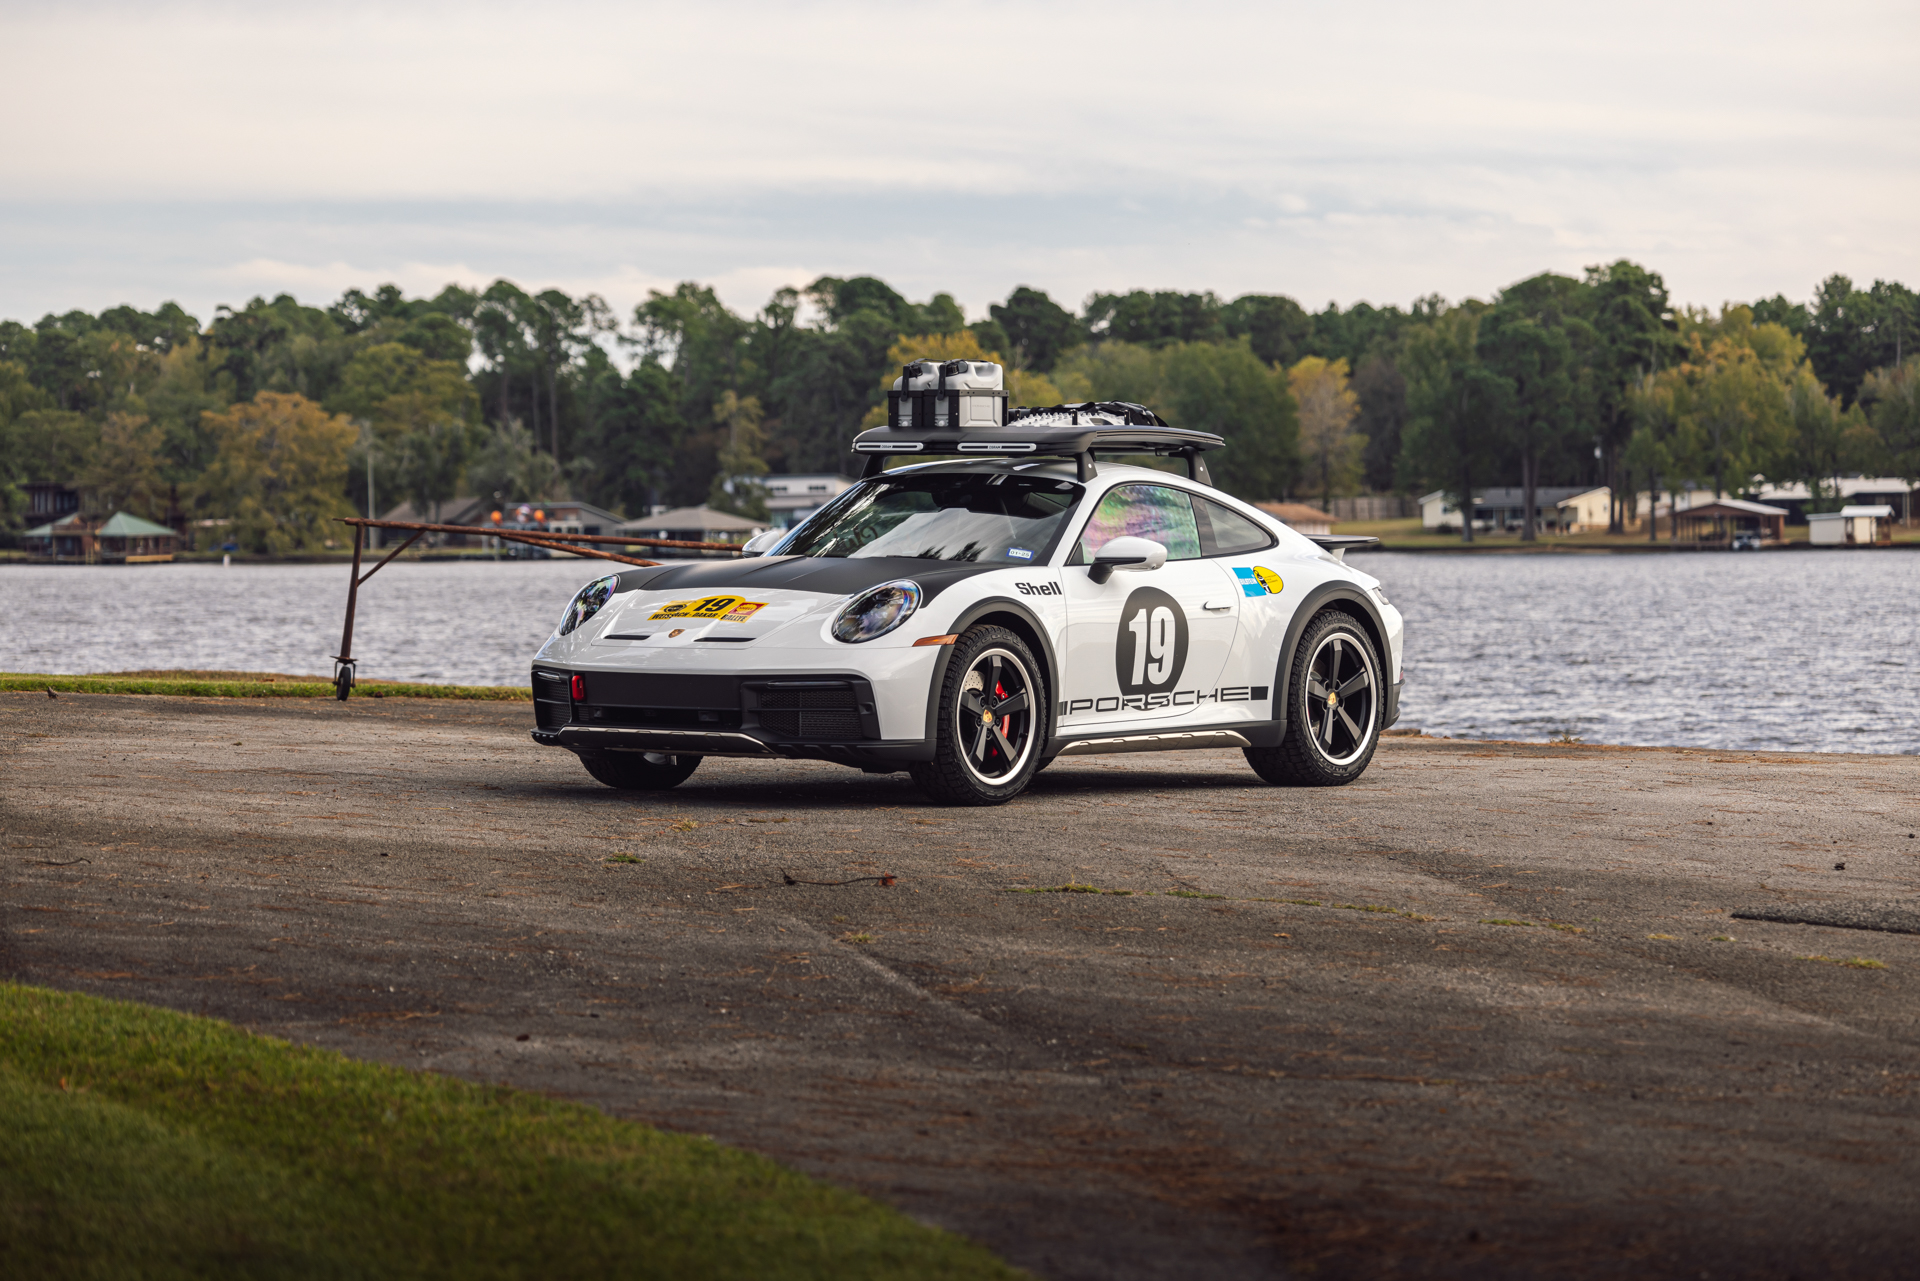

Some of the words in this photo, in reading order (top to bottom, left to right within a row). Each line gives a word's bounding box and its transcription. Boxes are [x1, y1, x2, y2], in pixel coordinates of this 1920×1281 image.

[1015, 582, 1063, 596] Shell
[693, 598, 735, 612] 19
[720, 613, 748, 622] RALLYE
[1128, 605, 1176, 686] 19
[1069, 686, 1249, 715] PORSCHE
